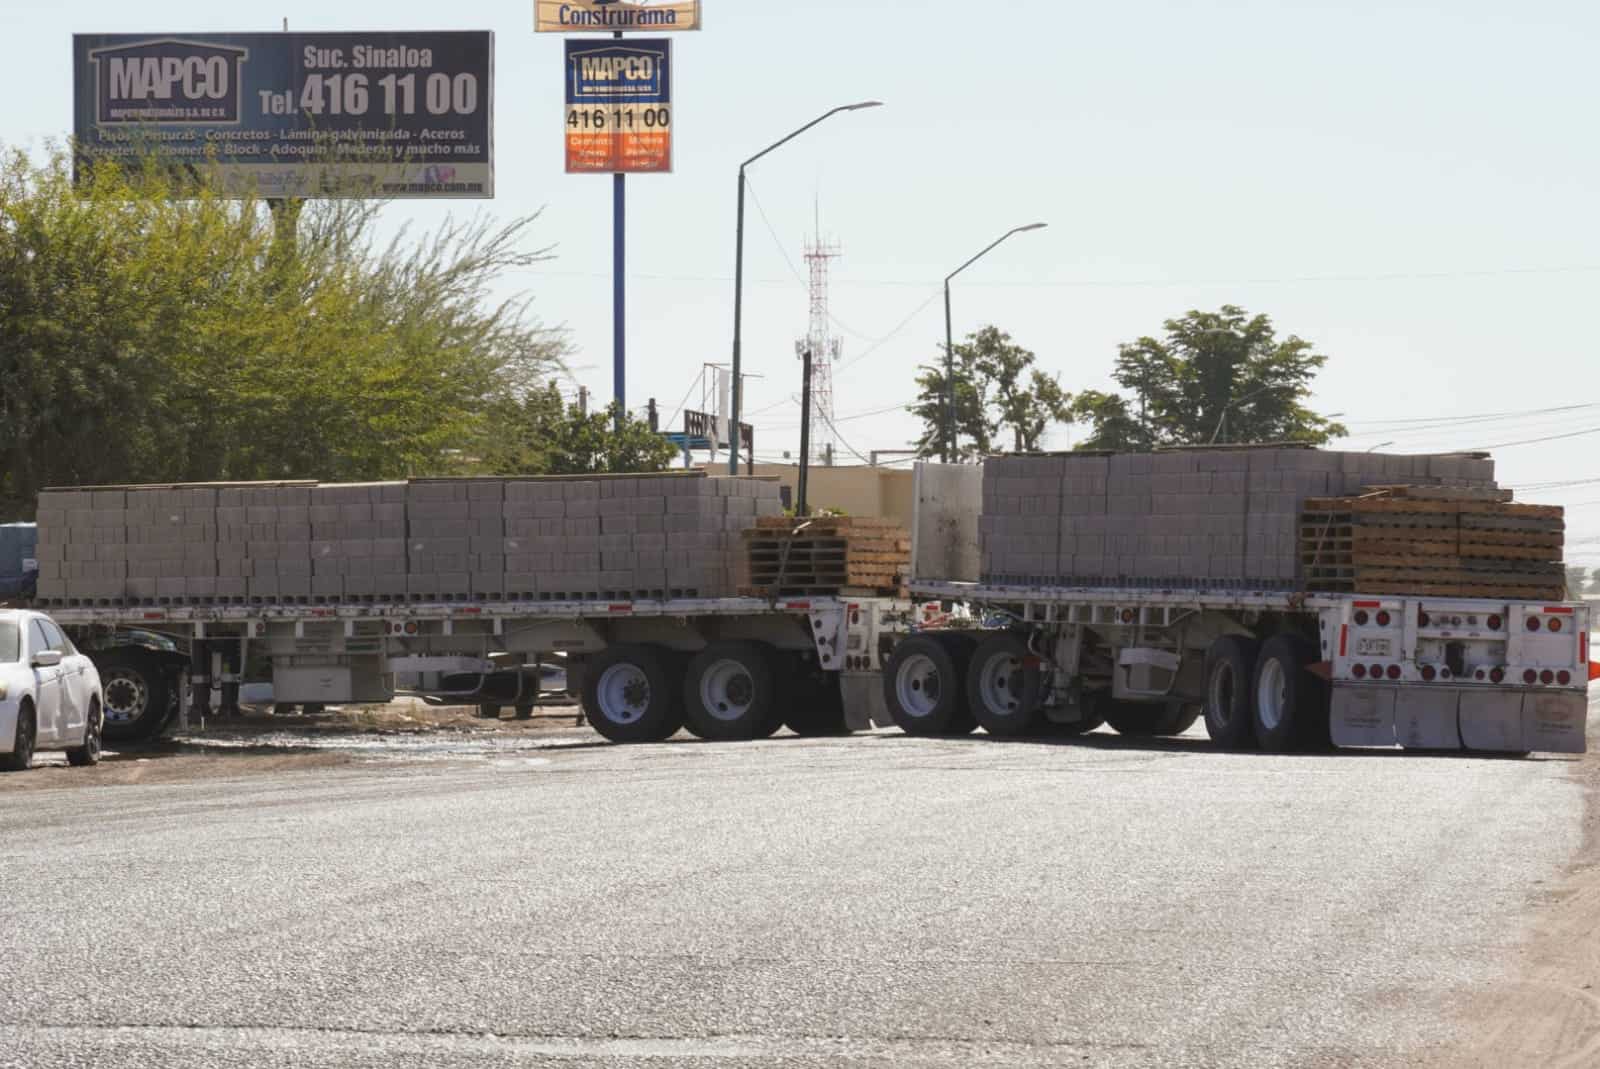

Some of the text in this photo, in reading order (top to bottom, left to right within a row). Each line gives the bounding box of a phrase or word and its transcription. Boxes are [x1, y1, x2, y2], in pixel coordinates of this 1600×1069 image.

[559, 4, 676, 25] Construrama
[304, 45, 433, 68] Suc. Sinaloa
[110, 56, 228, 100] MAPCO
[582, 56, 653, 81] MAPCO
[259, 72, 477, 115] Tel. 416 11 00
[567, 108, 669, 128] 416 11 00
[204, 129, 270, 141] Concretos
[329, 128, 410, 143] galvanizada
[420, 128, 465, 140] Aceros
[224, 143, 260, 155] Block
[395, 144, 404, 157] y
[406, 142, 450, 155] mucho
